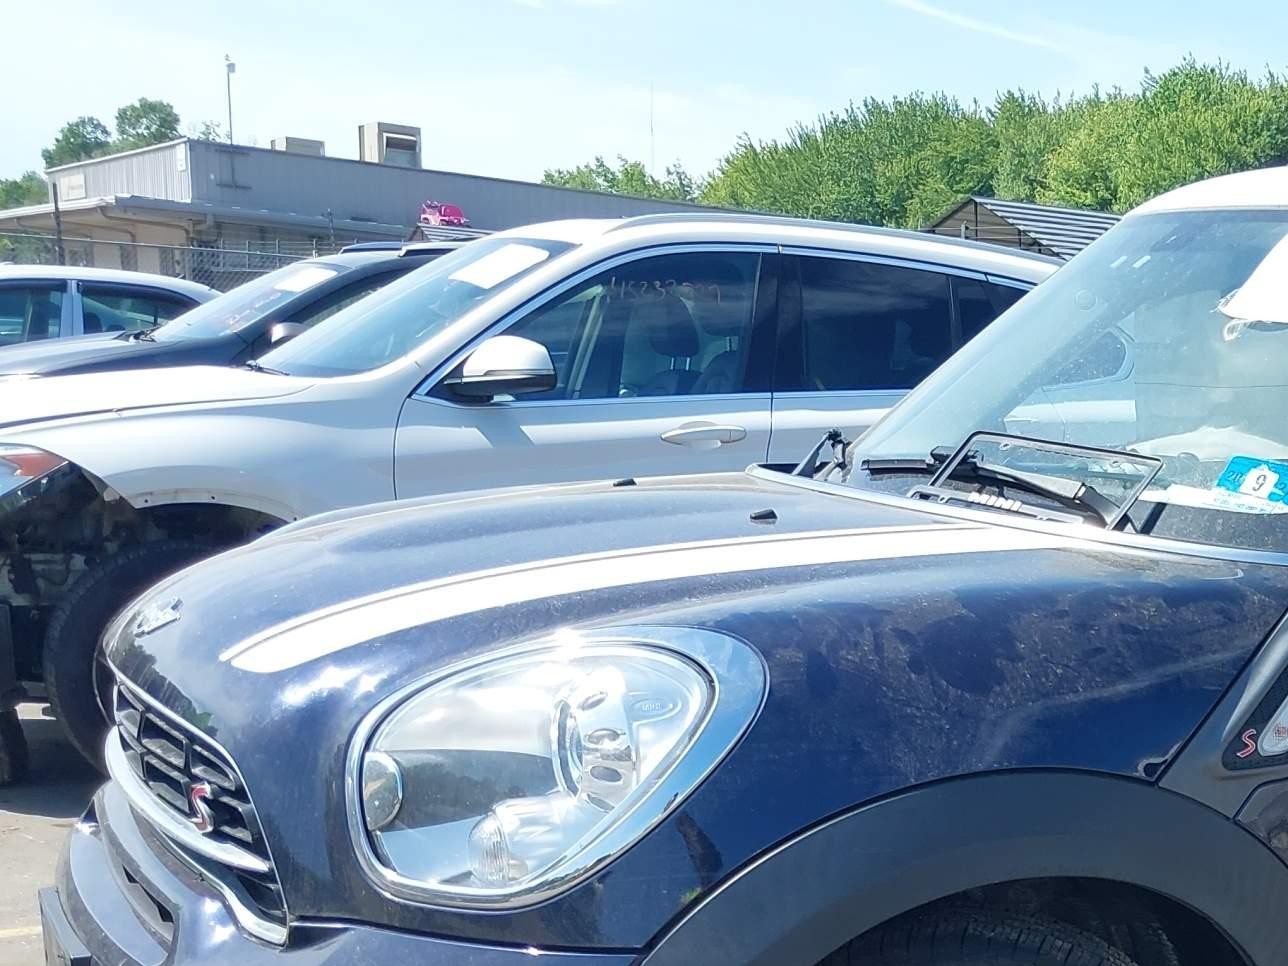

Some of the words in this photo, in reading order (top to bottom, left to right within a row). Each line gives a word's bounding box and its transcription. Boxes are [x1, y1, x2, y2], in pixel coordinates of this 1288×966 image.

[1252, 474, 1267, 492] 9
[967, 490, 1022, 512] MINI
[1236, 728, 1257, 758] S
[190, 781, 214, 833] S
